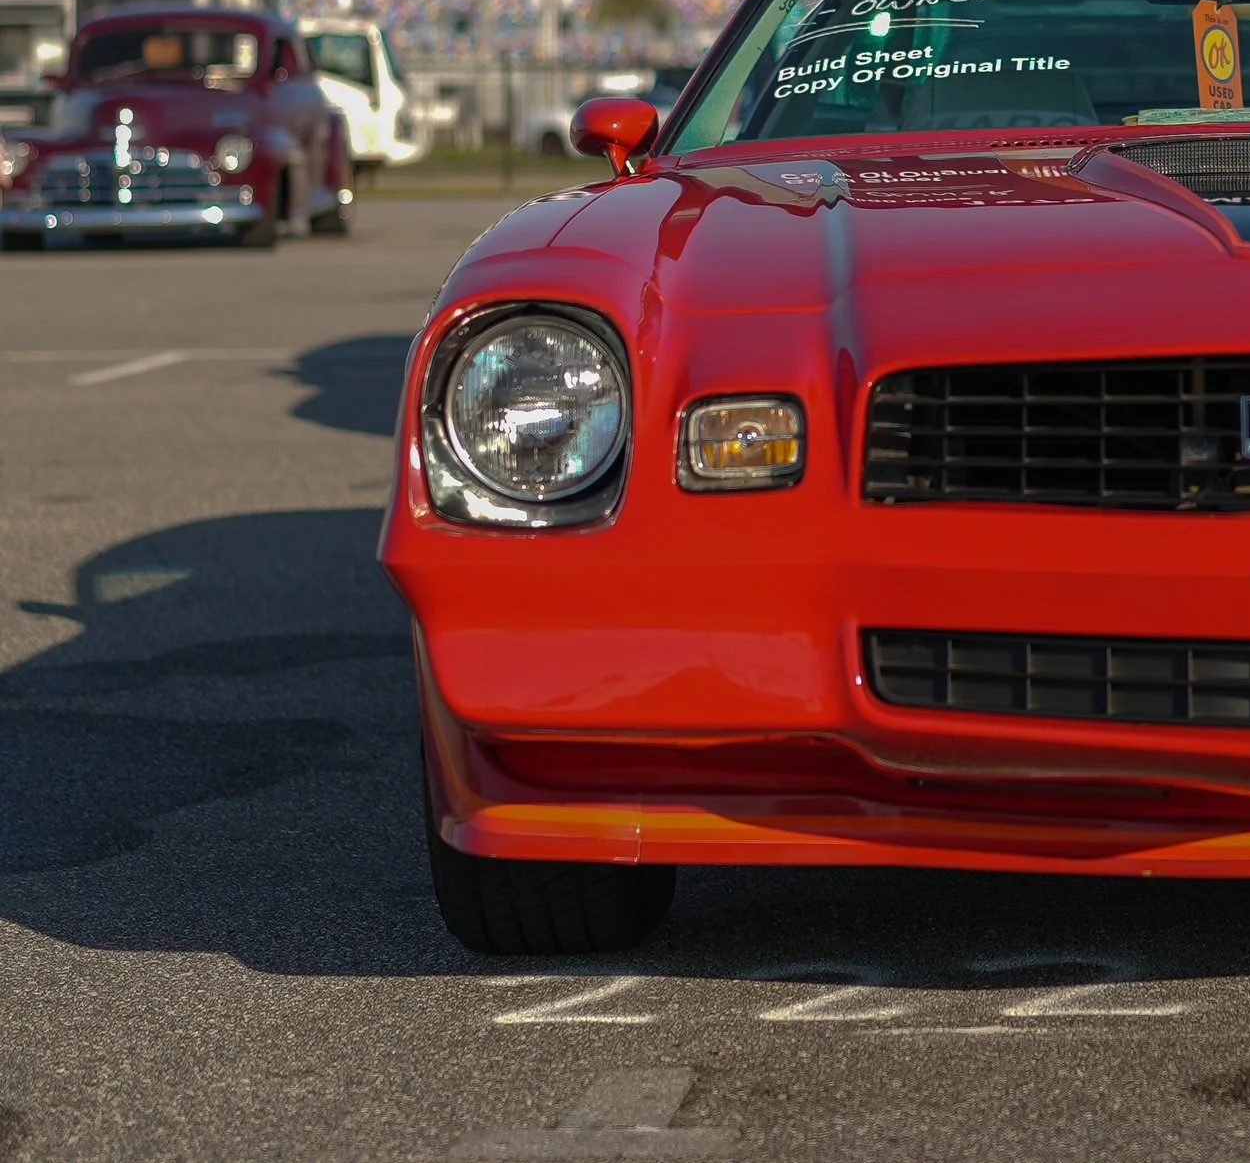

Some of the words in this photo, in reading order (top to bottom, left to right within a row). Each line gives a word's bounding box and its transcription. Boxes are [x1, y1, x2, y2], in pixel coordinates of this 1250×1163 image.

[776, 54, 847, 82] Build
[855, 45, 934, 66] Sheet
[1208, 37, 1231, 70] OK
[773, 76, 844, 100] Copy
[852, 67, 886, 84] Of
[892, 58, 1002, 82] Original
[1010, 56, 1072, 72] Title
[1208, 85, 1234, 100] USED
